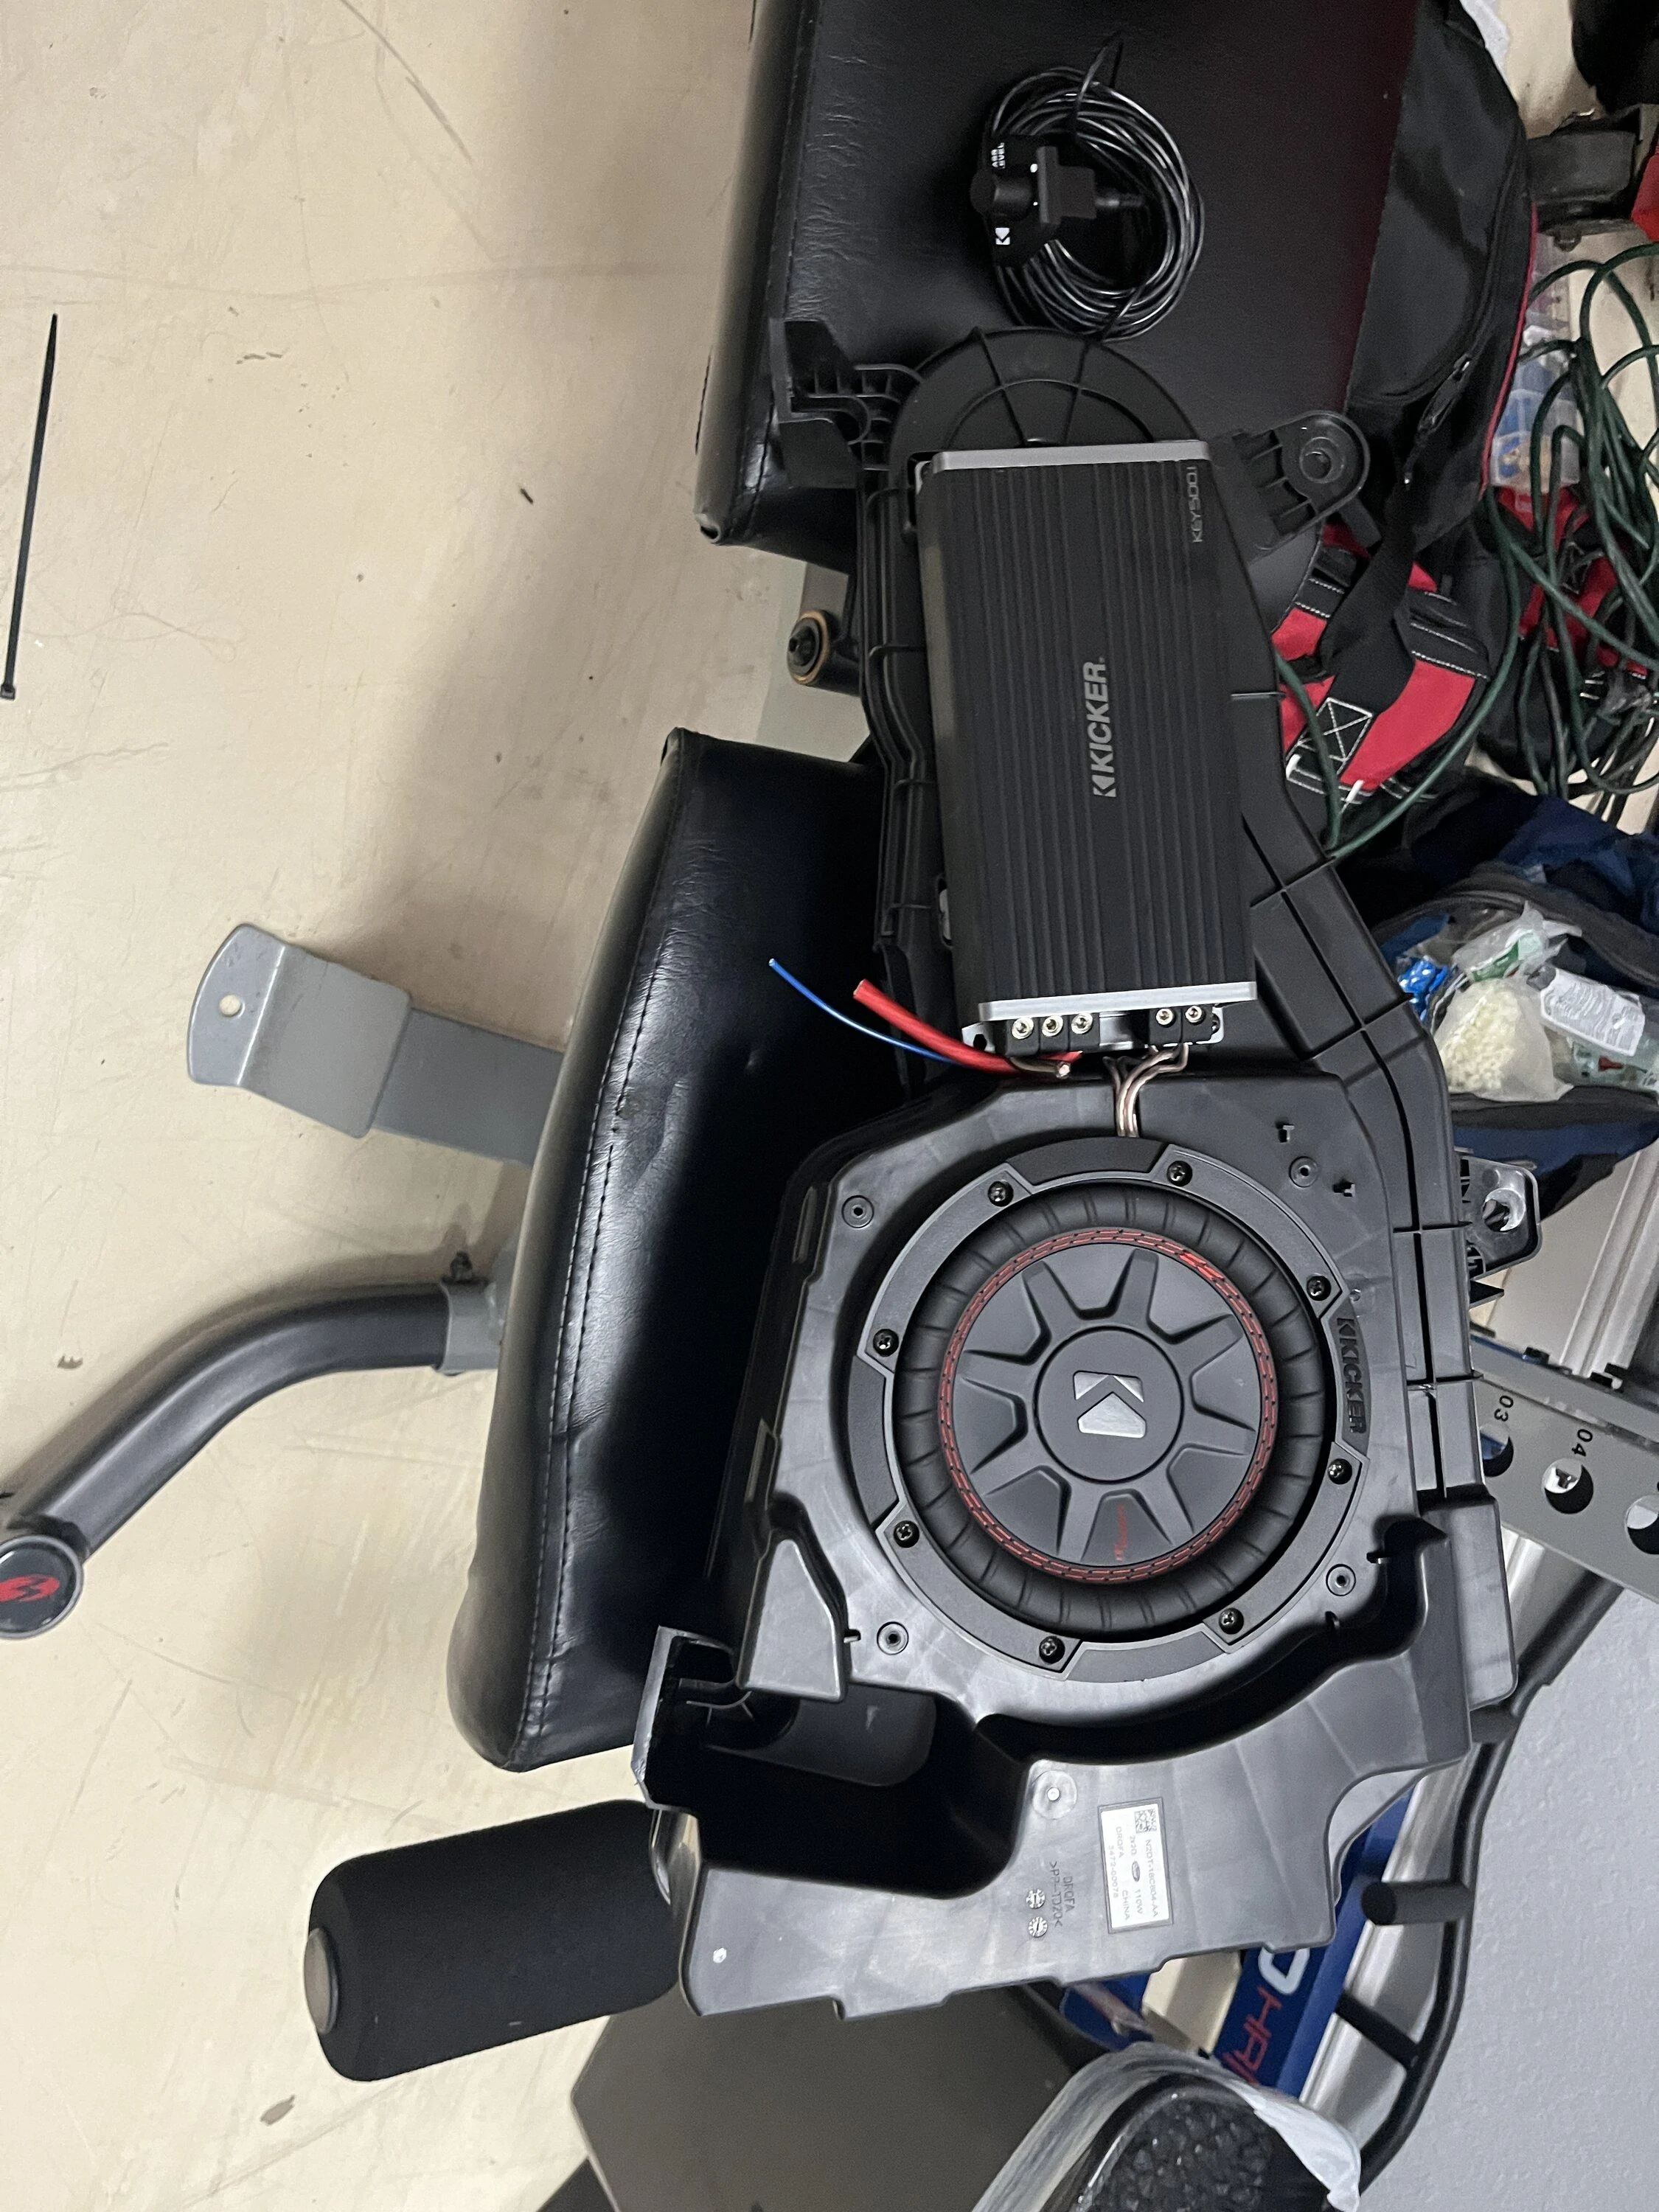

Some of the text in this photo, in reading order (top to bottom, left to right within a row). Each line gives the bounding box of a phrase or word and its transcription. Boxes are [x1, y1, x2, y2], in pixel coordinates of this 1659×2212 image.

[1494, 1395, 1514, 1422] 03
[1571, 1429, 1593, 1457] 04
[1121, 1890, 1130, 1921] CHINA
